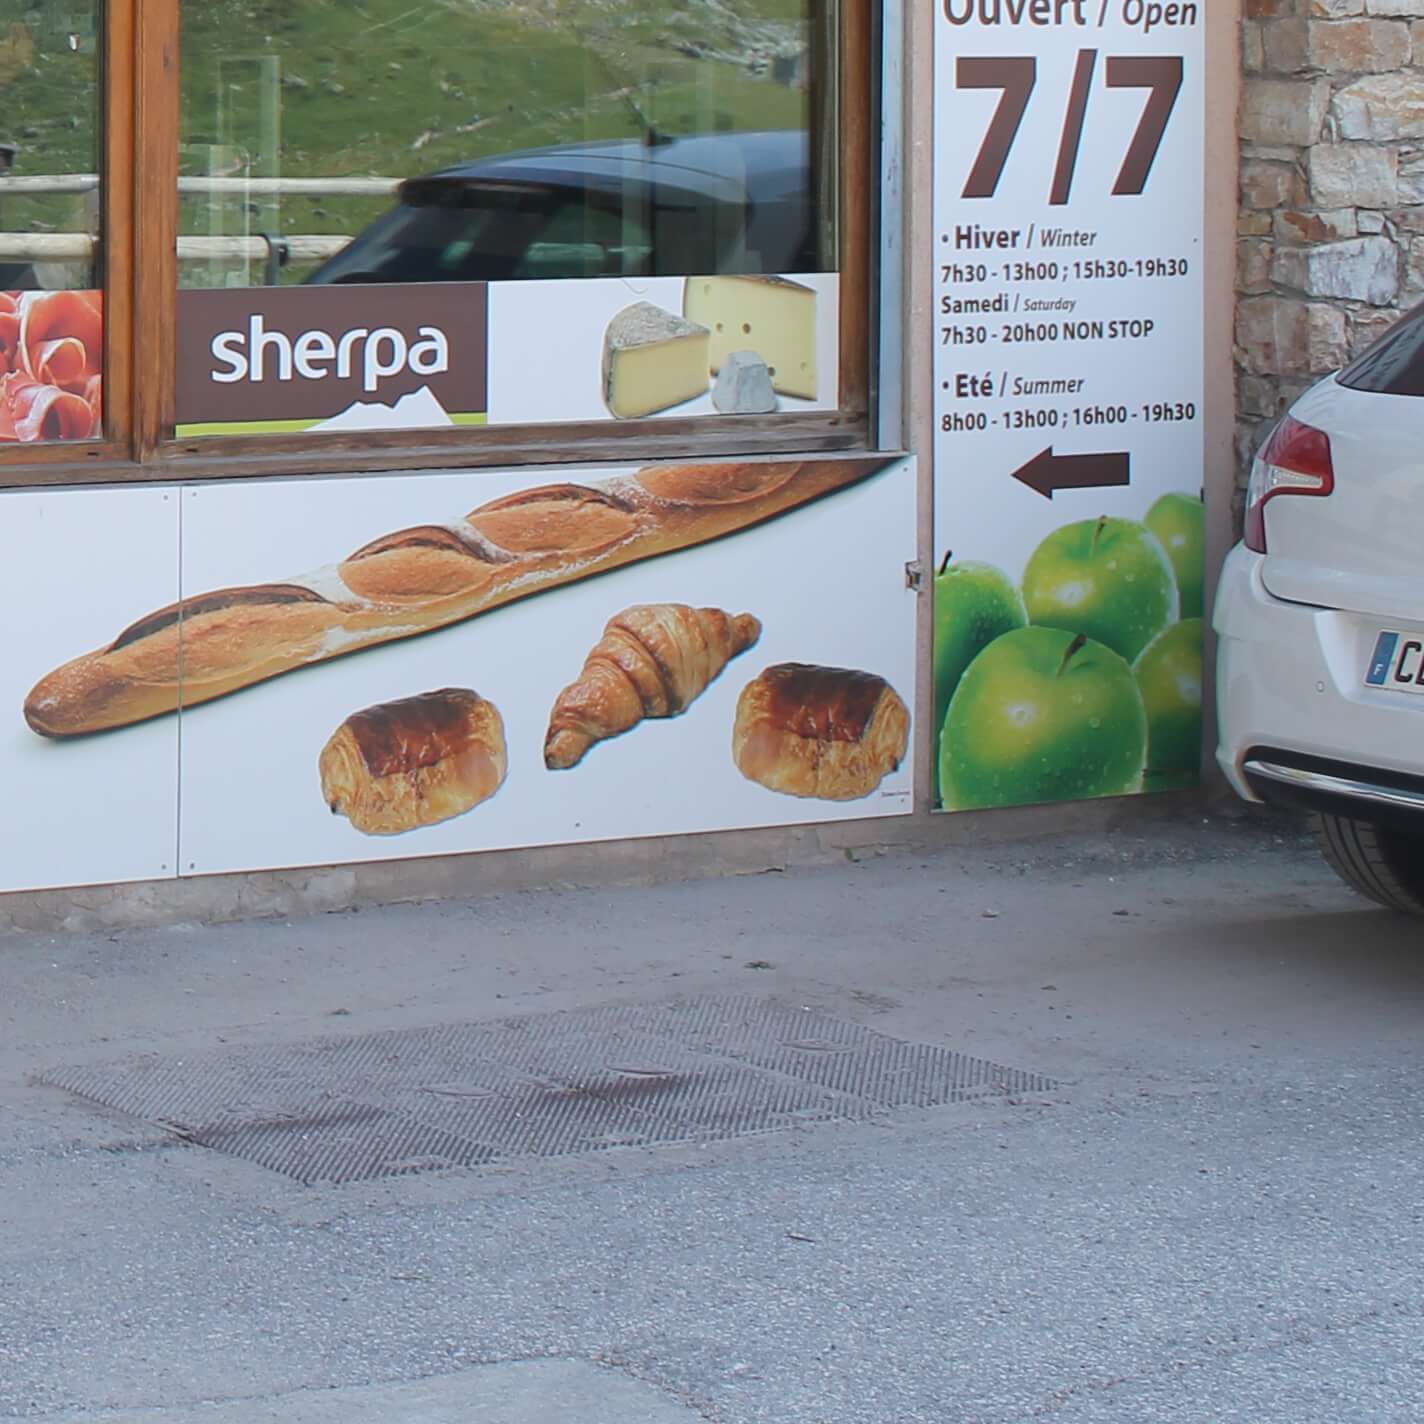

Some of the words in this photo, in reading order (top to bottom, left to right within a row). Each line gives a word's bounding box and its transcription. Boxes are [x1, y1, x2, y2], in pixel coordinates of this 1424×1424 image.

[956, 48, 1184, 205] 7/7
[955, 224, 1020, 249] Hiver
[1040, 229, 1097, 247] Winter
[942, 265, 986, 283] 7h30
[1003, 263, 1057, 281] 13h00
[1073, 259, 1188, 279] 15h30-19h30
[941, 294, 1009, 314] Samedi
[1023, 297, 1076, 312] Saturday
[942, 327, 986, 345] 7h30
[1002, 325, 1057, 343] 20h00
[1063, 323, 1103, 340] NON
[1108, 320, 1154, 338] STOP
[211, 314, 449, 392] sherpa
[955, 372, 993, 398] Eté
[1013, 377, 1084, 395] Summer
[942, 414, 987, 432] 8h00
[1003, 410, 1057, 429] 13h00
[1073, 406, 1127, 425] 16h00
[1142, 403, 1195, 422] 19h30
